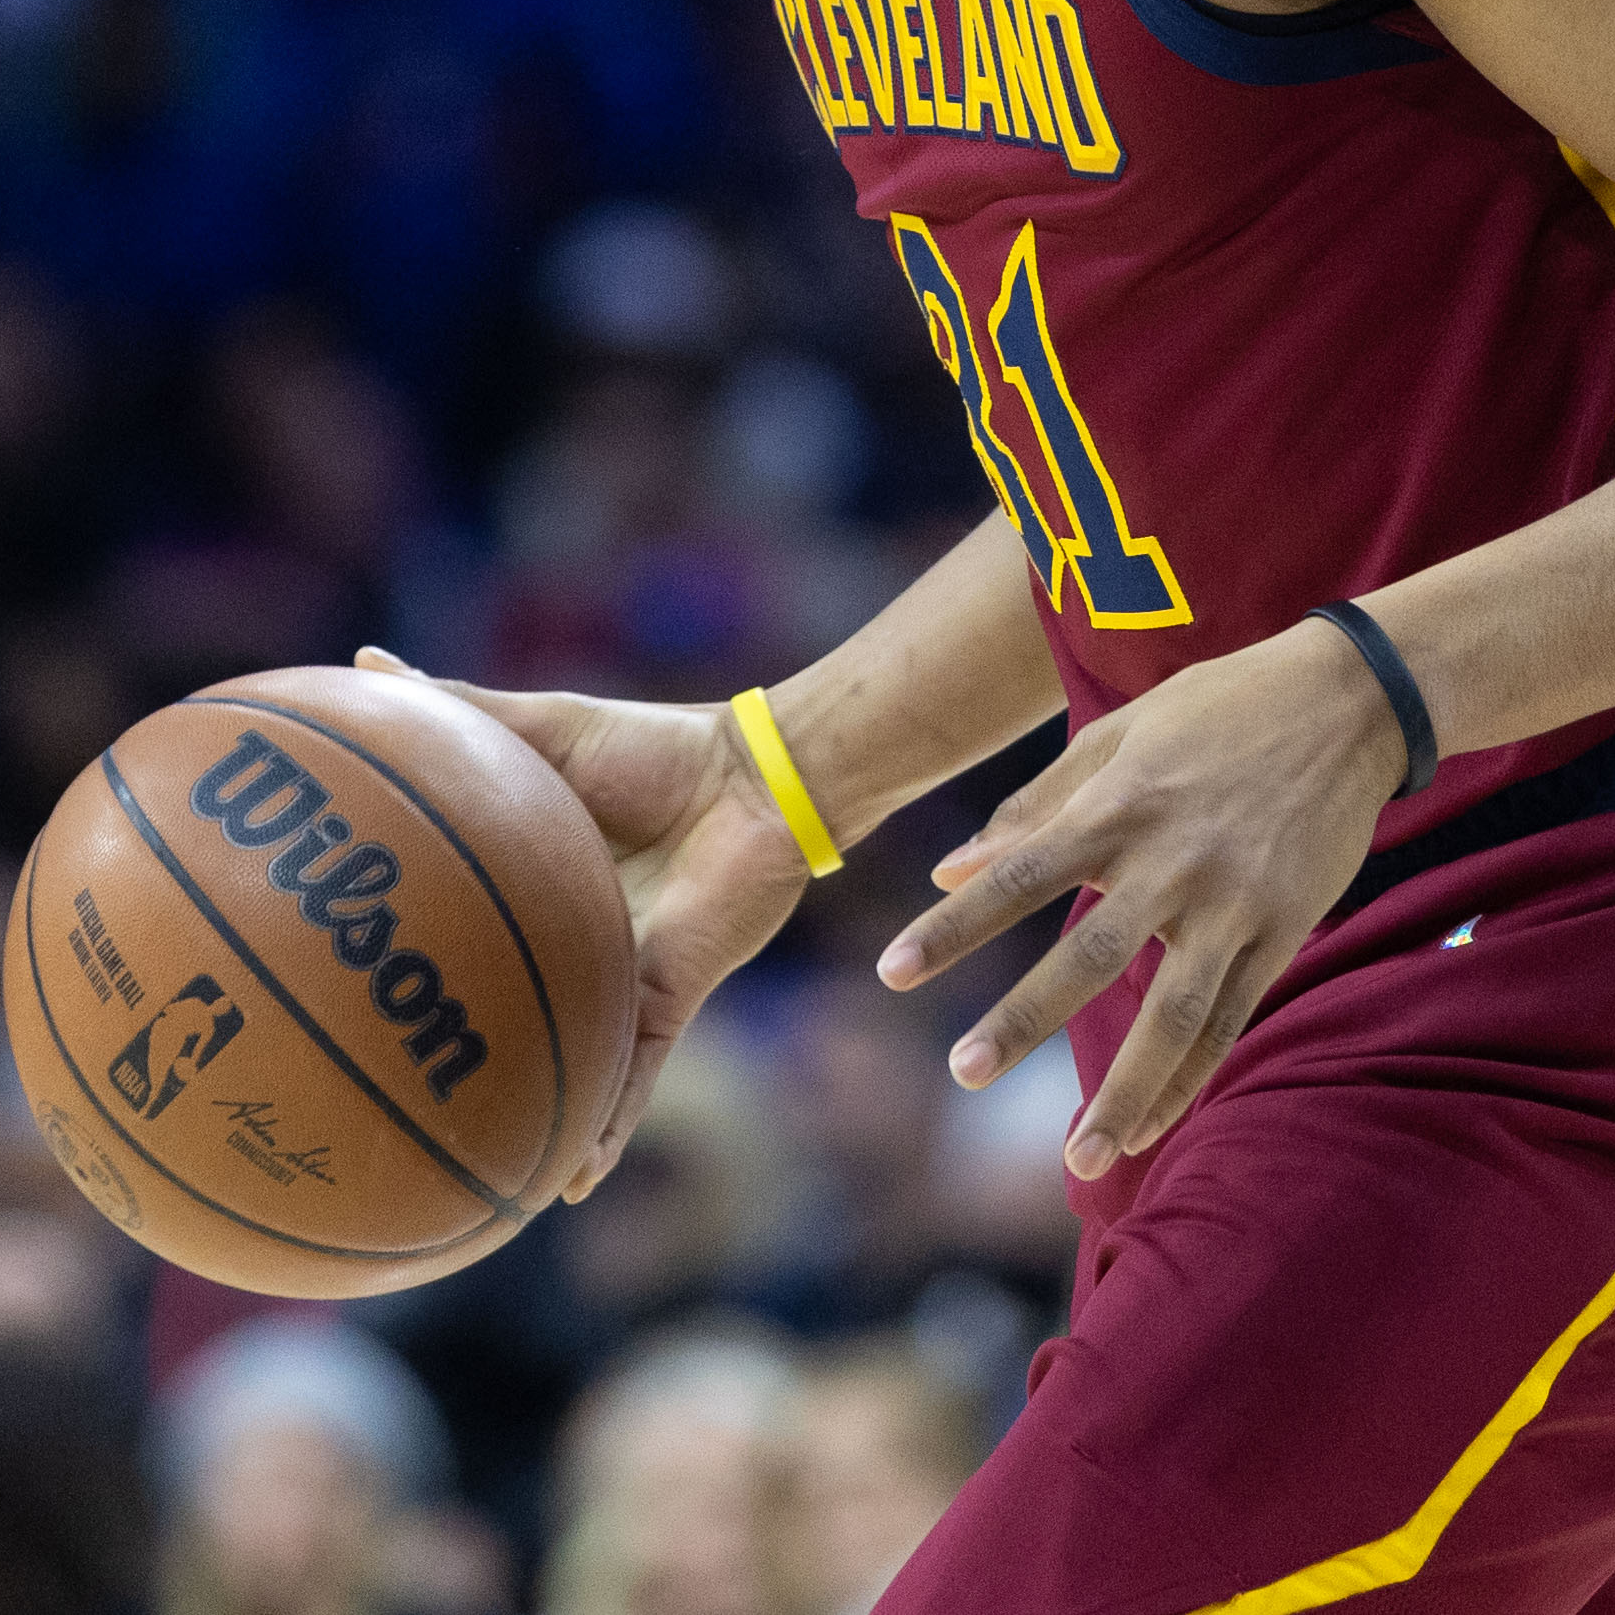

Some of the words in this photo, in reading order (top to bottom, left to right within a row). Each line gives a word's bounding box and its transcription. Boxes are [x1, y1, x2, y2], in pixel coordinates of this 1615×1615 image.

[73, 888, 106, 947] OFFICIAL
[96, 937, 126, 981] GAME
[115, 970, 145, 1011] BALL
[189, 729, 490, 1104] Wilson
[113, 1059, 146, 1101] NBA
